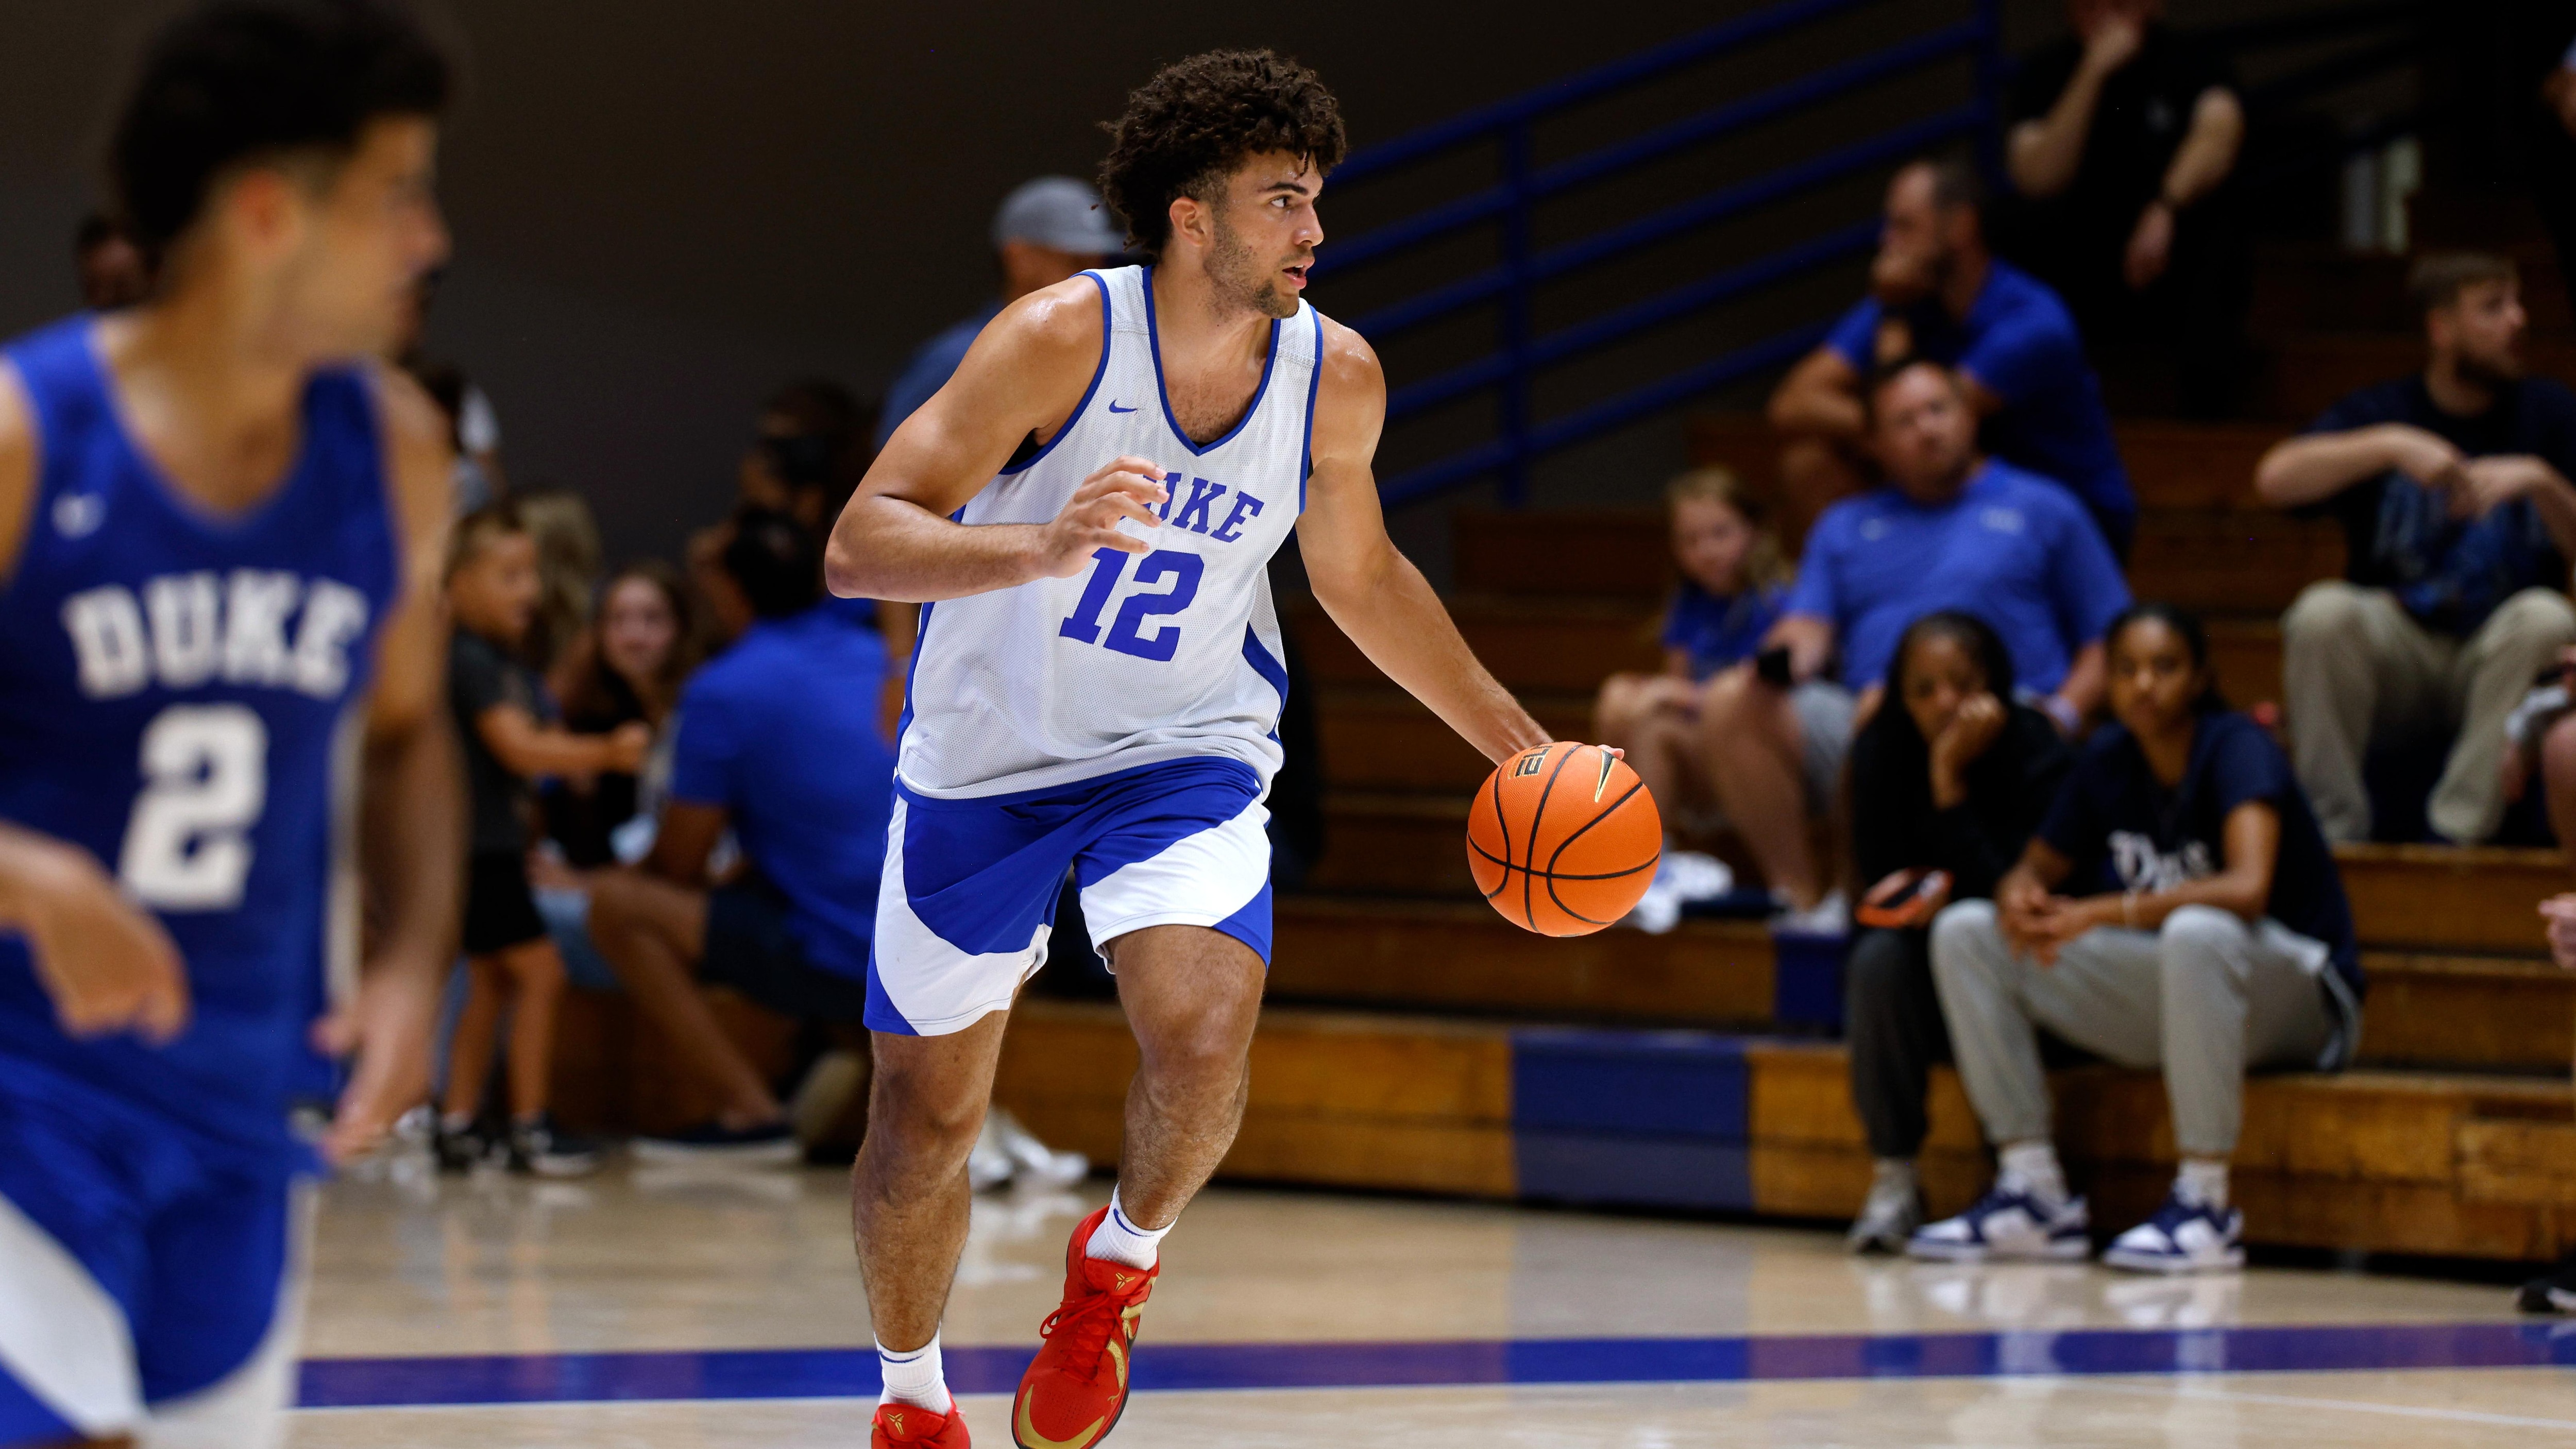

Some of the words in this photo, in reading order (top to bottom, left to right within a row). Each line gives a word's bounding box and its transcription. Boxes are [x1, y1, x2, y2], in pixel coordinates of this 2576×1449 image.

[1120, 472, 1264, 542] UKE
[62, 568, 369, 700] DUKE
[1059, 547, 1205, 661] 12
[121, 704, 268, 910] 2
